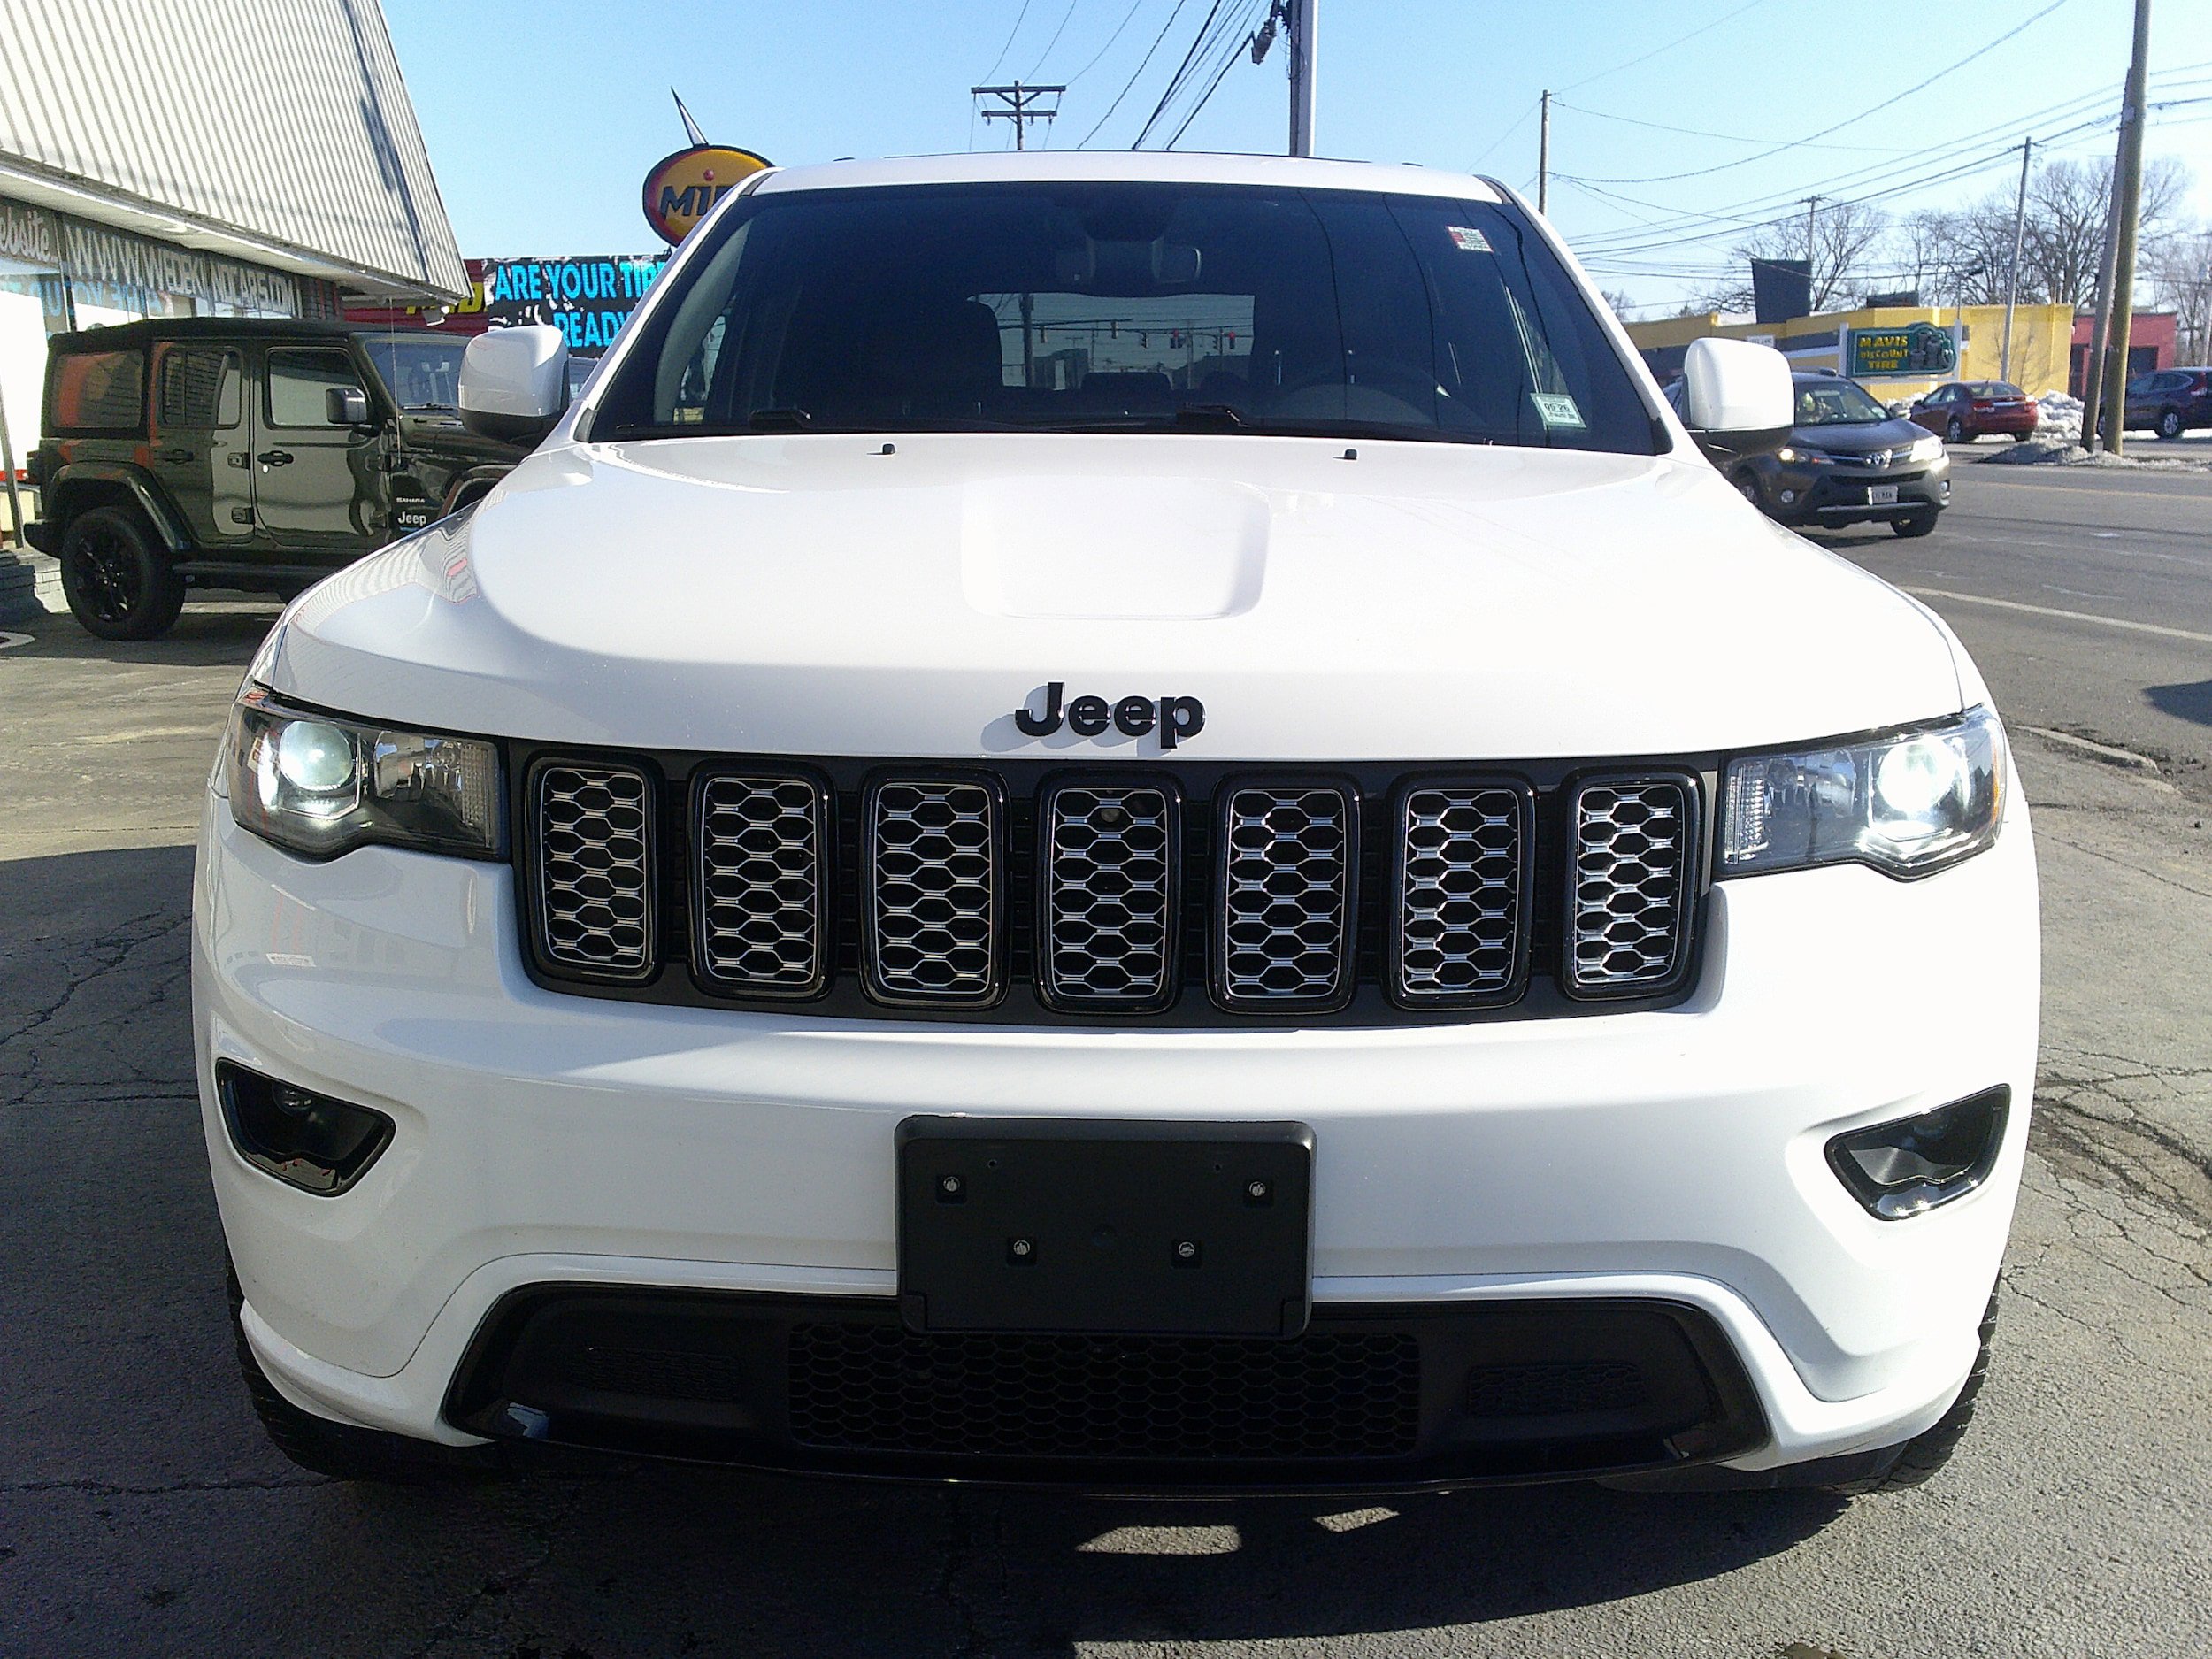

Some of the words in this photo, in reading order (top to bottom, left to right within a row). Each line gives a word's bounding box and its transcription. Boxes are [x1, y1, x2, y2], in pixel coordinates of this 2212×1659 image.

[495, 264, 542, 301] ARE
[546, 262, 618, 299] YOUR
[1859, 335, 1908, 348] MAVIS
[397, 511, 426, 526] Jeep
[1015, 681, 1206, 749] Jeep
